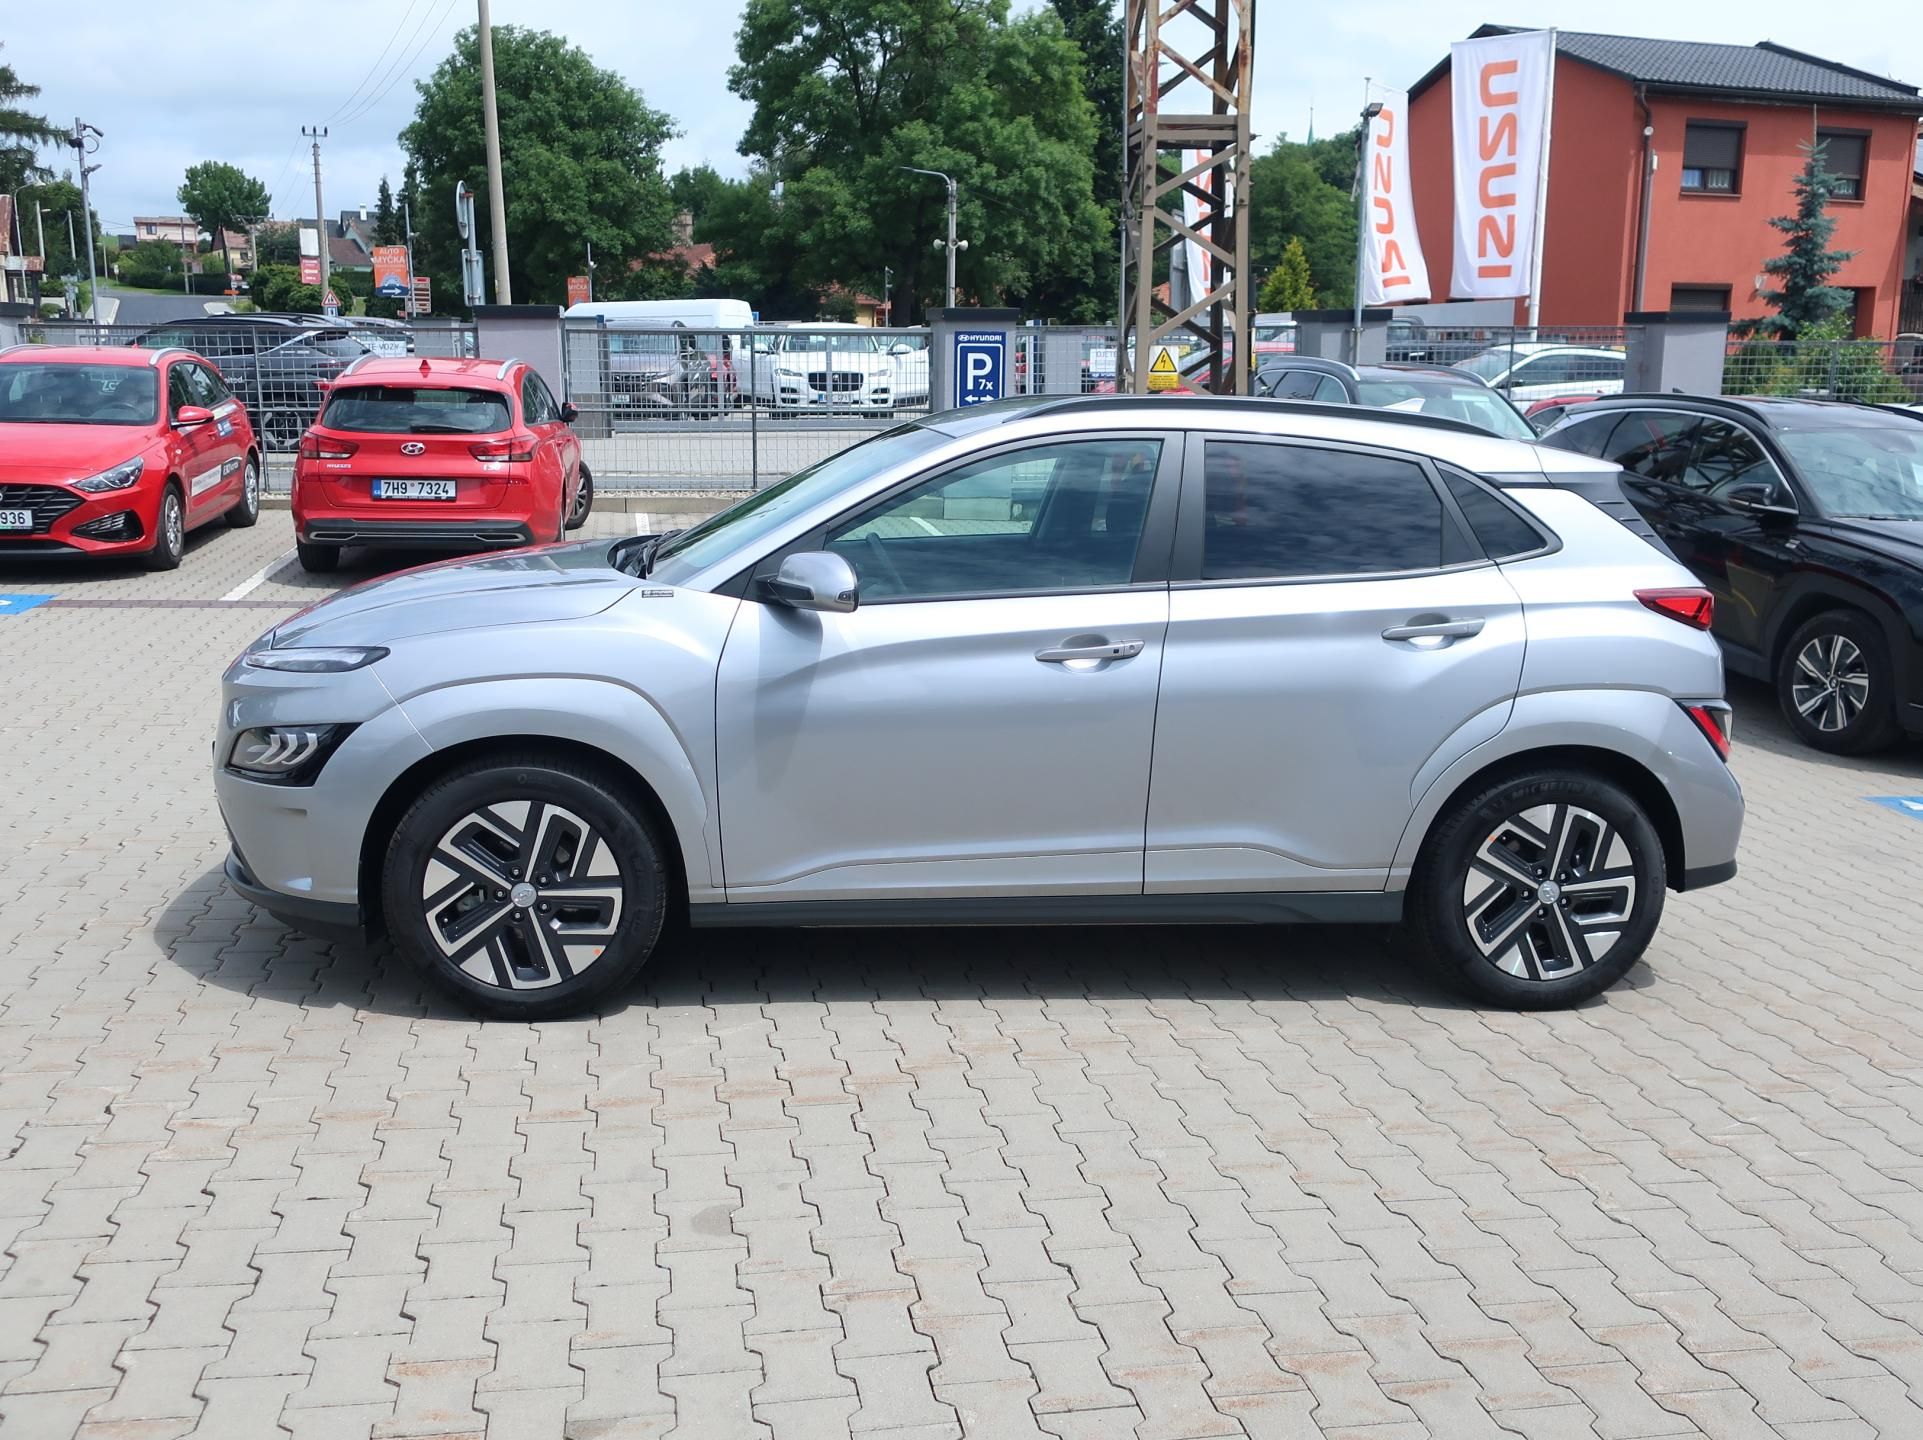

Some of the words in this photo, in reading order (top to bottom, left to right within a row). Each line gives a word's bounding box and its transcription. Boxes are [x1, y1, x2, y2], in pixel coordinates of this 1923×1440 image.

[1373, 106, 1412, 289] ISUZU
[970, 334, 1002, 342] HYUNDAI
[967, 352, 993, 390] P
[978, 379, 994, 391] 7x
[383, 481, 408, 495] 7H9
[418, 481, 449, 495] 7324
[0, 511, 26, 525] 936
